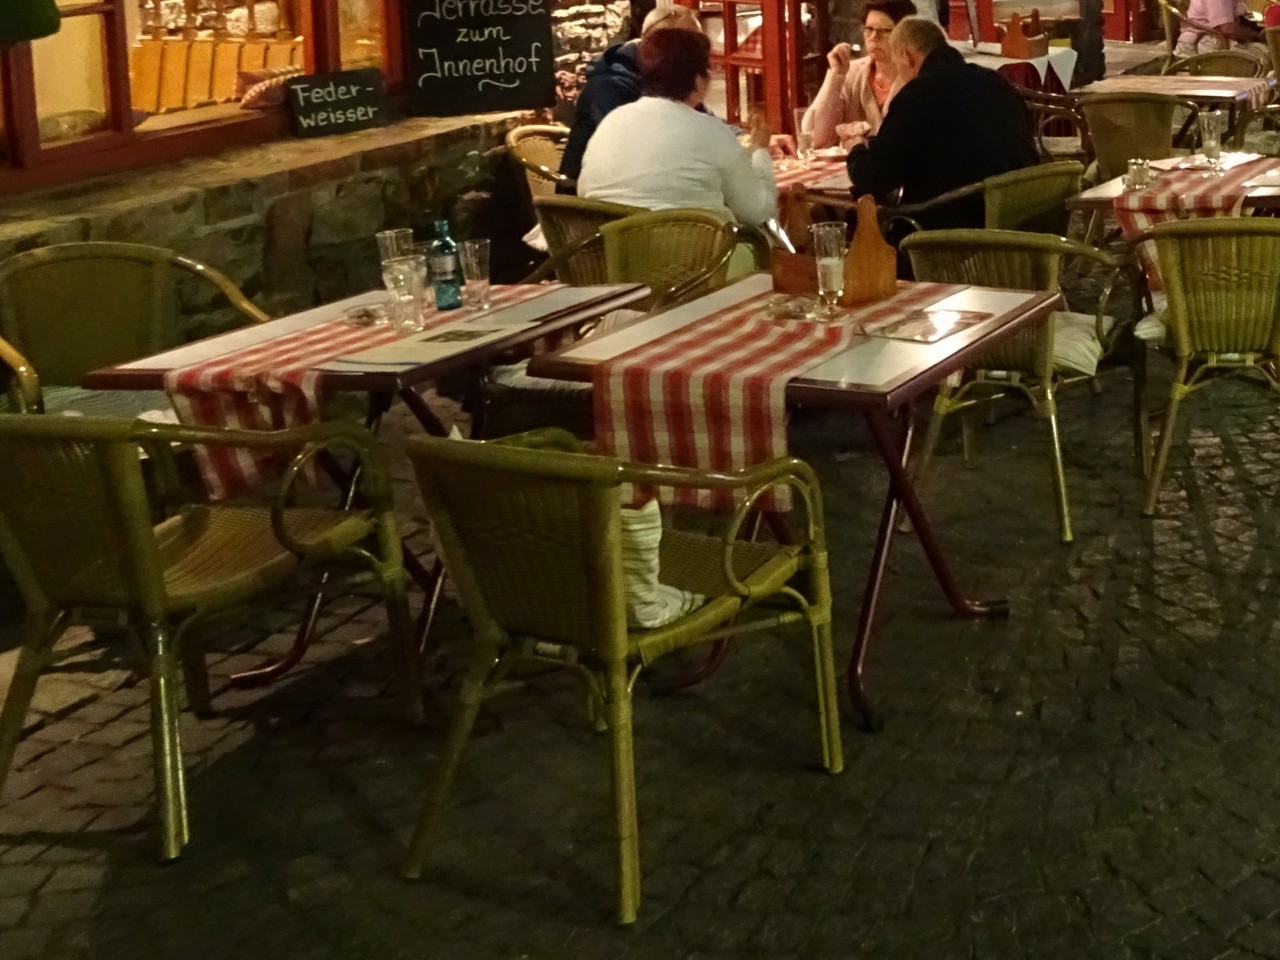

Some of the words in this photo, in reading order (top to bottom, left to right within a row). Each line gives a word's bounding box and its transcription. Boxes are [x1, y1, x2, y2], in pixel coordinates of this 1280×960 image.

[456, 25, 511, 44] zum
[418, 42, 542, 88] Innenhof
[291, 81, 375, 107] Feder-
[299, 104, 379, 129] weisser
